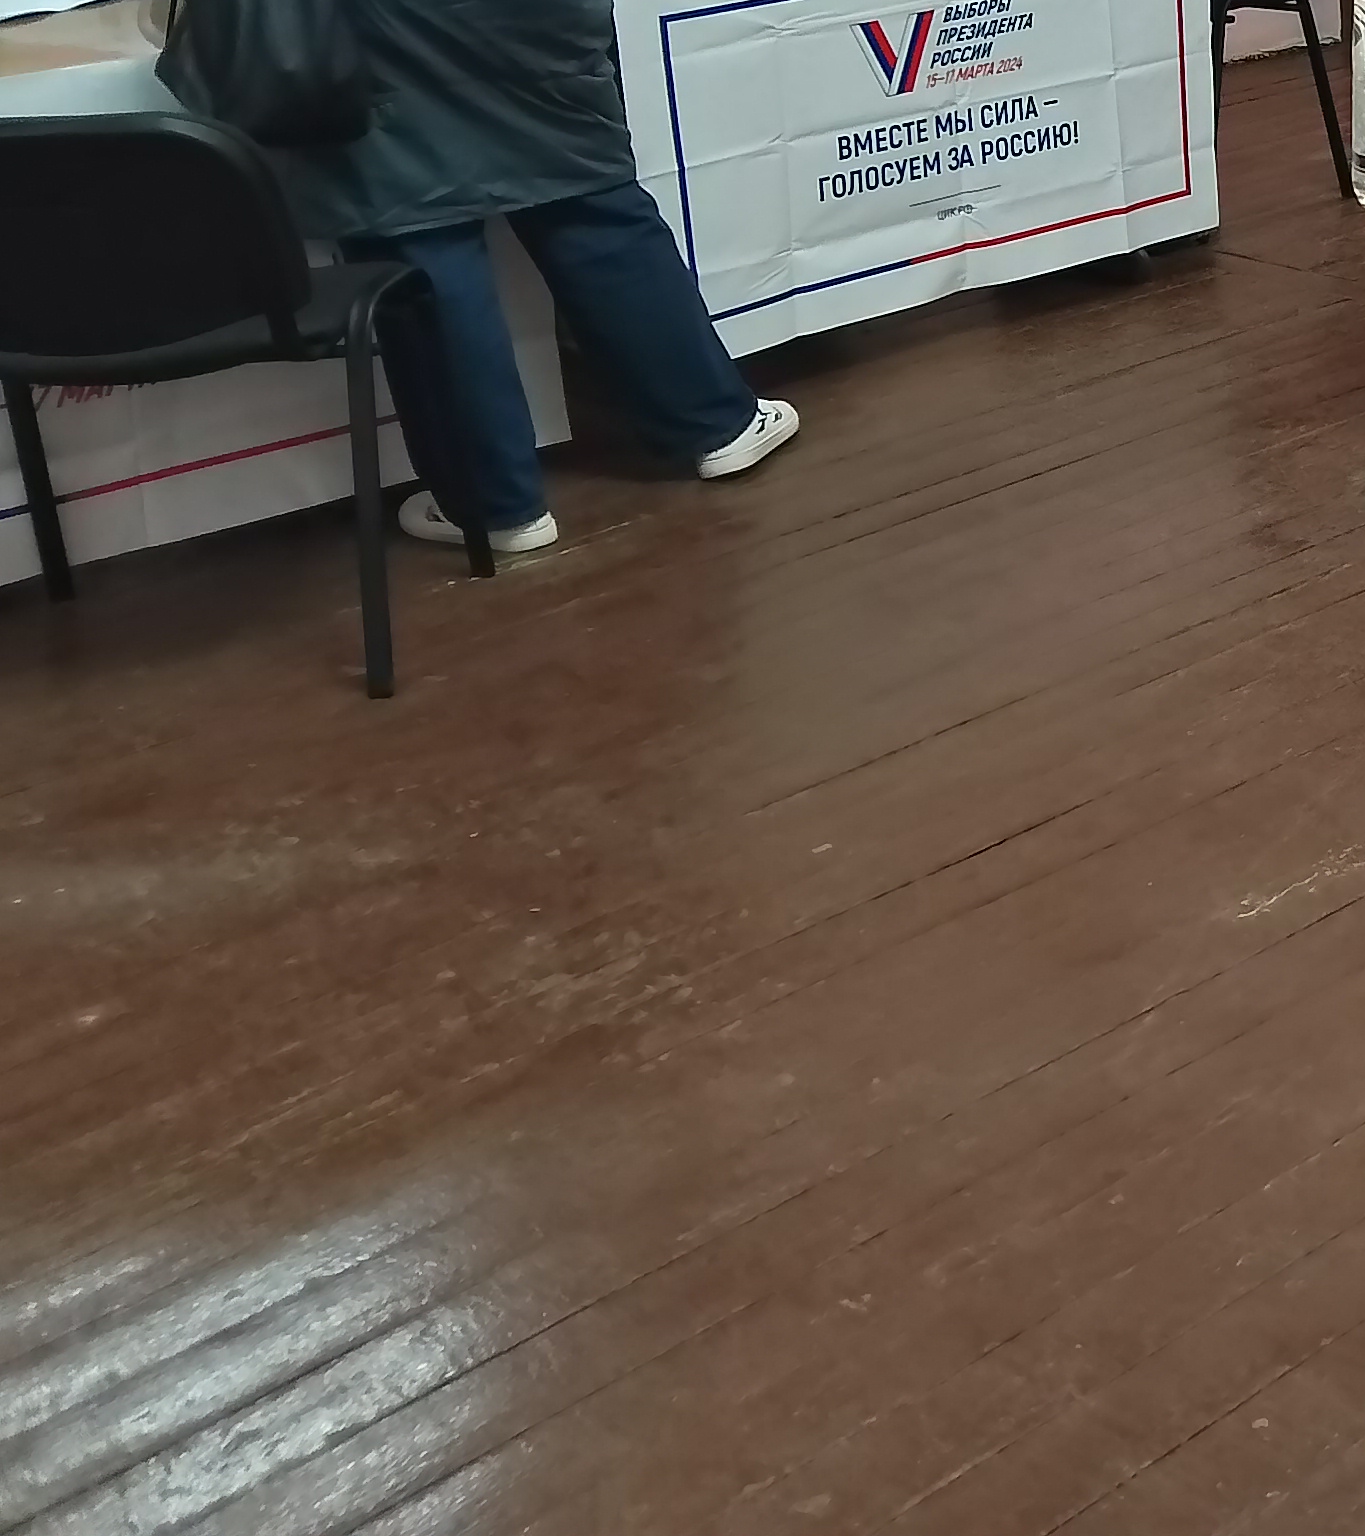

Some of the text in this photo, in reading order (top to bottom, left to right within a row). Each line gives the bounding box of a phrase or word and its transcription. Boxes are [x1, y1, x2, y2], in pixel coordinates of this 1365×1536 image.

[936, 13, 1034, 46] ПРЕЗИДЕНТА
[930, 42, 993, 69] РОССИИ
[956, 62, 994, 82] МАРТА
[996, 56, 1024, 75] 2024
[837, 118, 929, 161] ВМЕСТЕ
[935, 107, 974, 139] МЫ
[981, 95, 1039, 129] СИЛА
[818, 120, 1080, 202] ГОЛОСУЕМ ЗА РОССИЮ!
